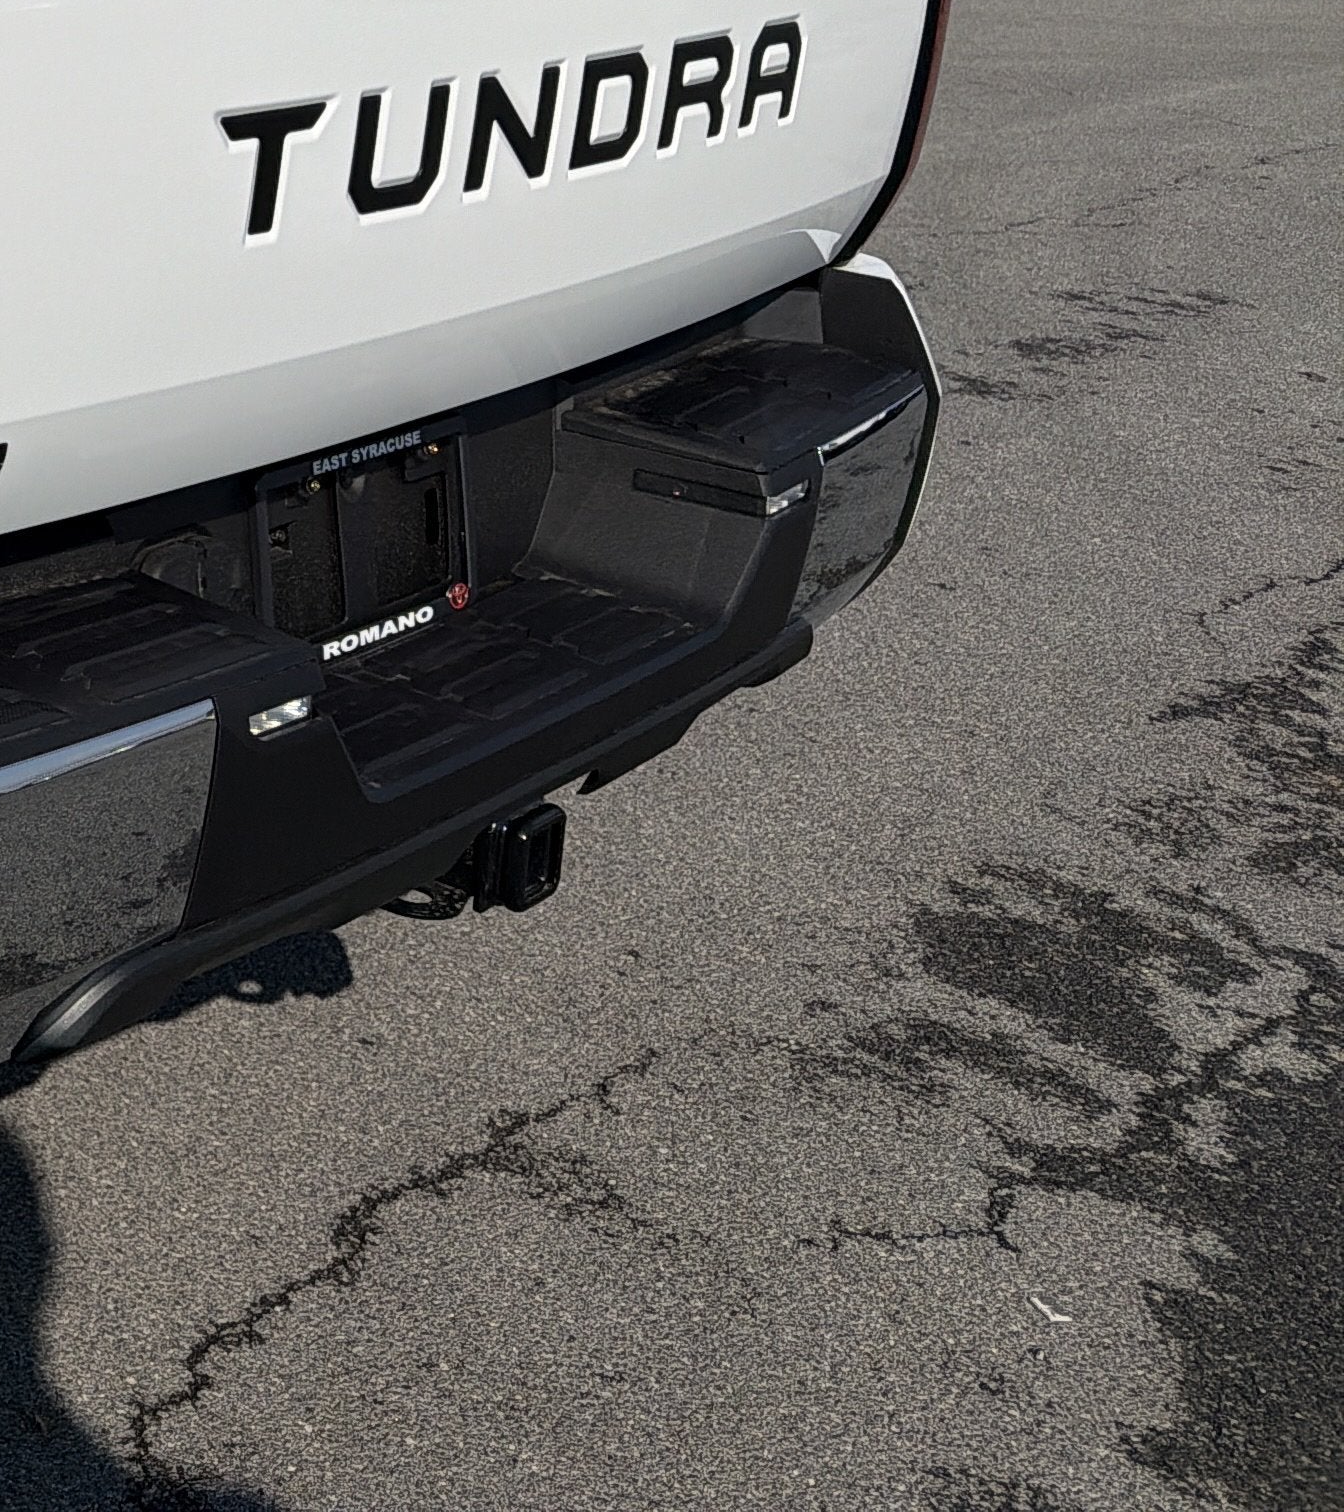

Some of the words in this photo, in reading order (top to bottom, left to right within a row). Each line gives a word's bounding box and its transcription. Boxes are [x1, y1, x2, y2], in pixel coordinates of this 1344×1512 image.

[216, 16, 805, 242] TUNDRA
[312, 452, 348, 475] EAST
[351, 430, 422, 464] SYRACUSE
[322, 606, 434, 660] ROMANO
